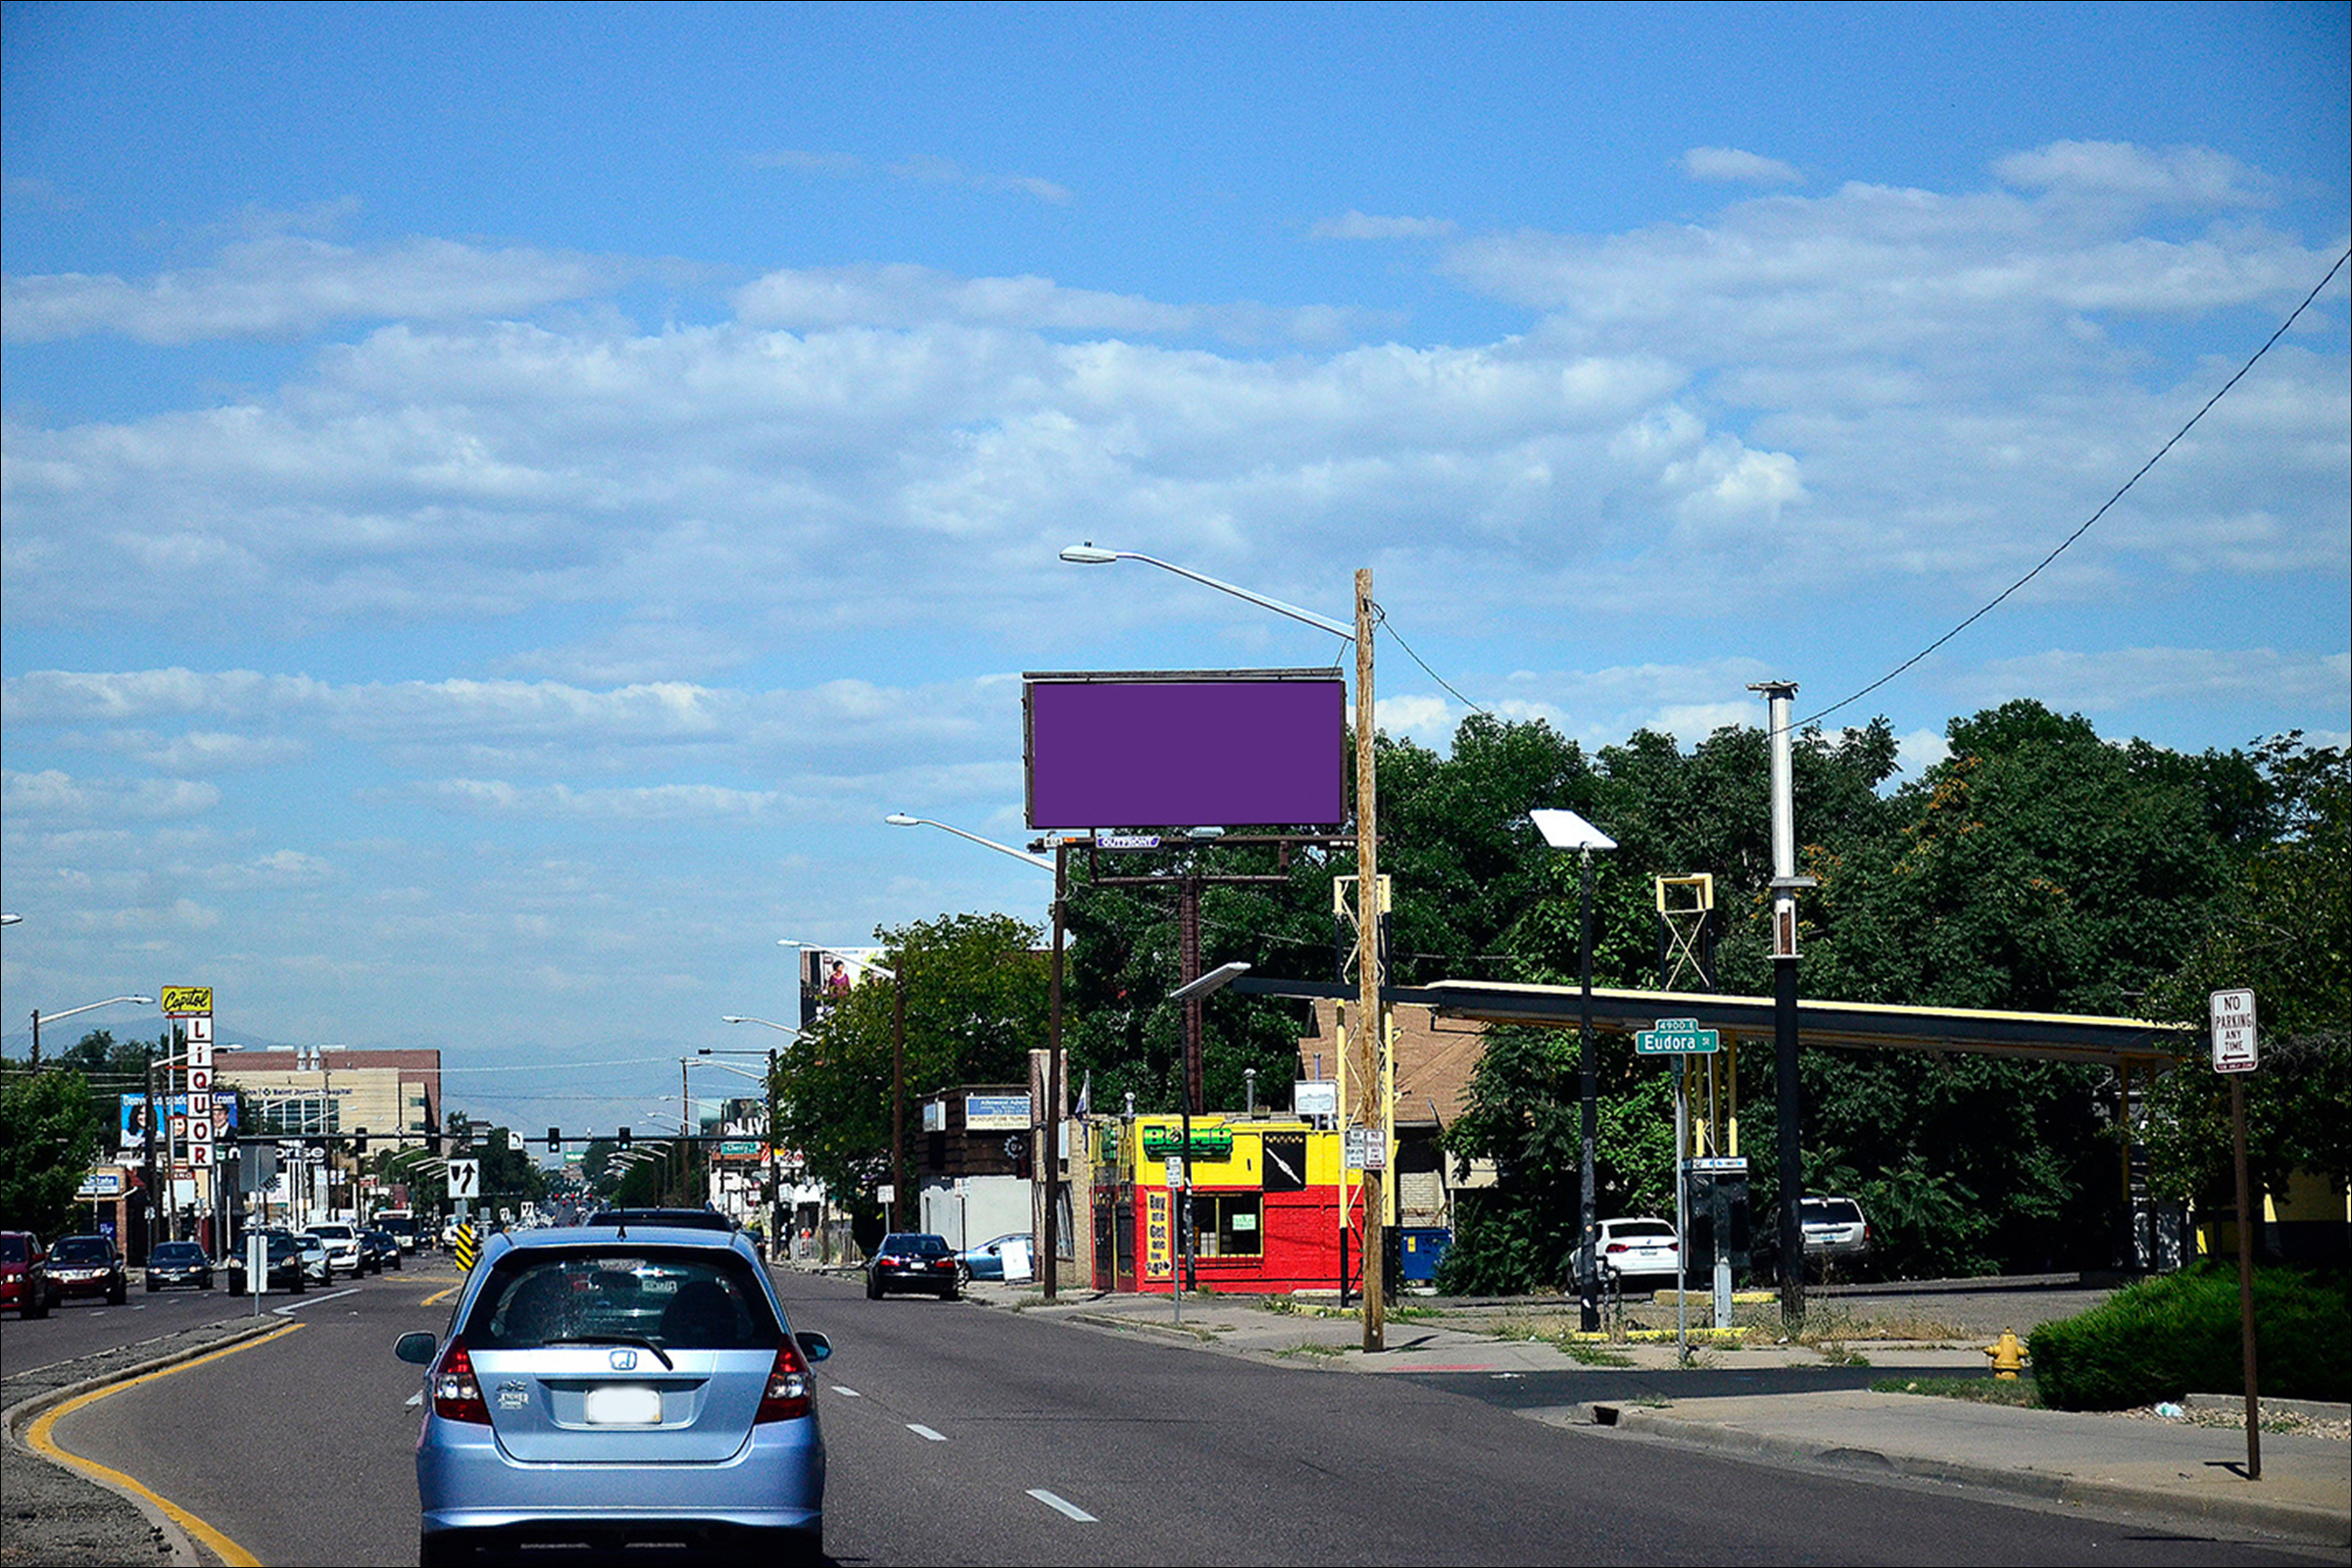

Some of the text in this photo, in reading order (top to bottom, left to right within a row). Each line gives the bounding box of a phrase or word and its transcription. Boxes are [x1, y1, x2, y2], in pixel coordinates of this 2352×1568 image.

[164, 989, 209, 1011] Capitol
[2224, 995, 2241, 1011] NO
[1659, 1021, 1686, 1030] 4900
[2216, 1012, 2252, 1029] PARKING
[1644, 1034, 1696, 1051] Eudora
[2226, 1030, 2242, 1039] ANY
[2225, 1041, 2244, 1052] TIME
